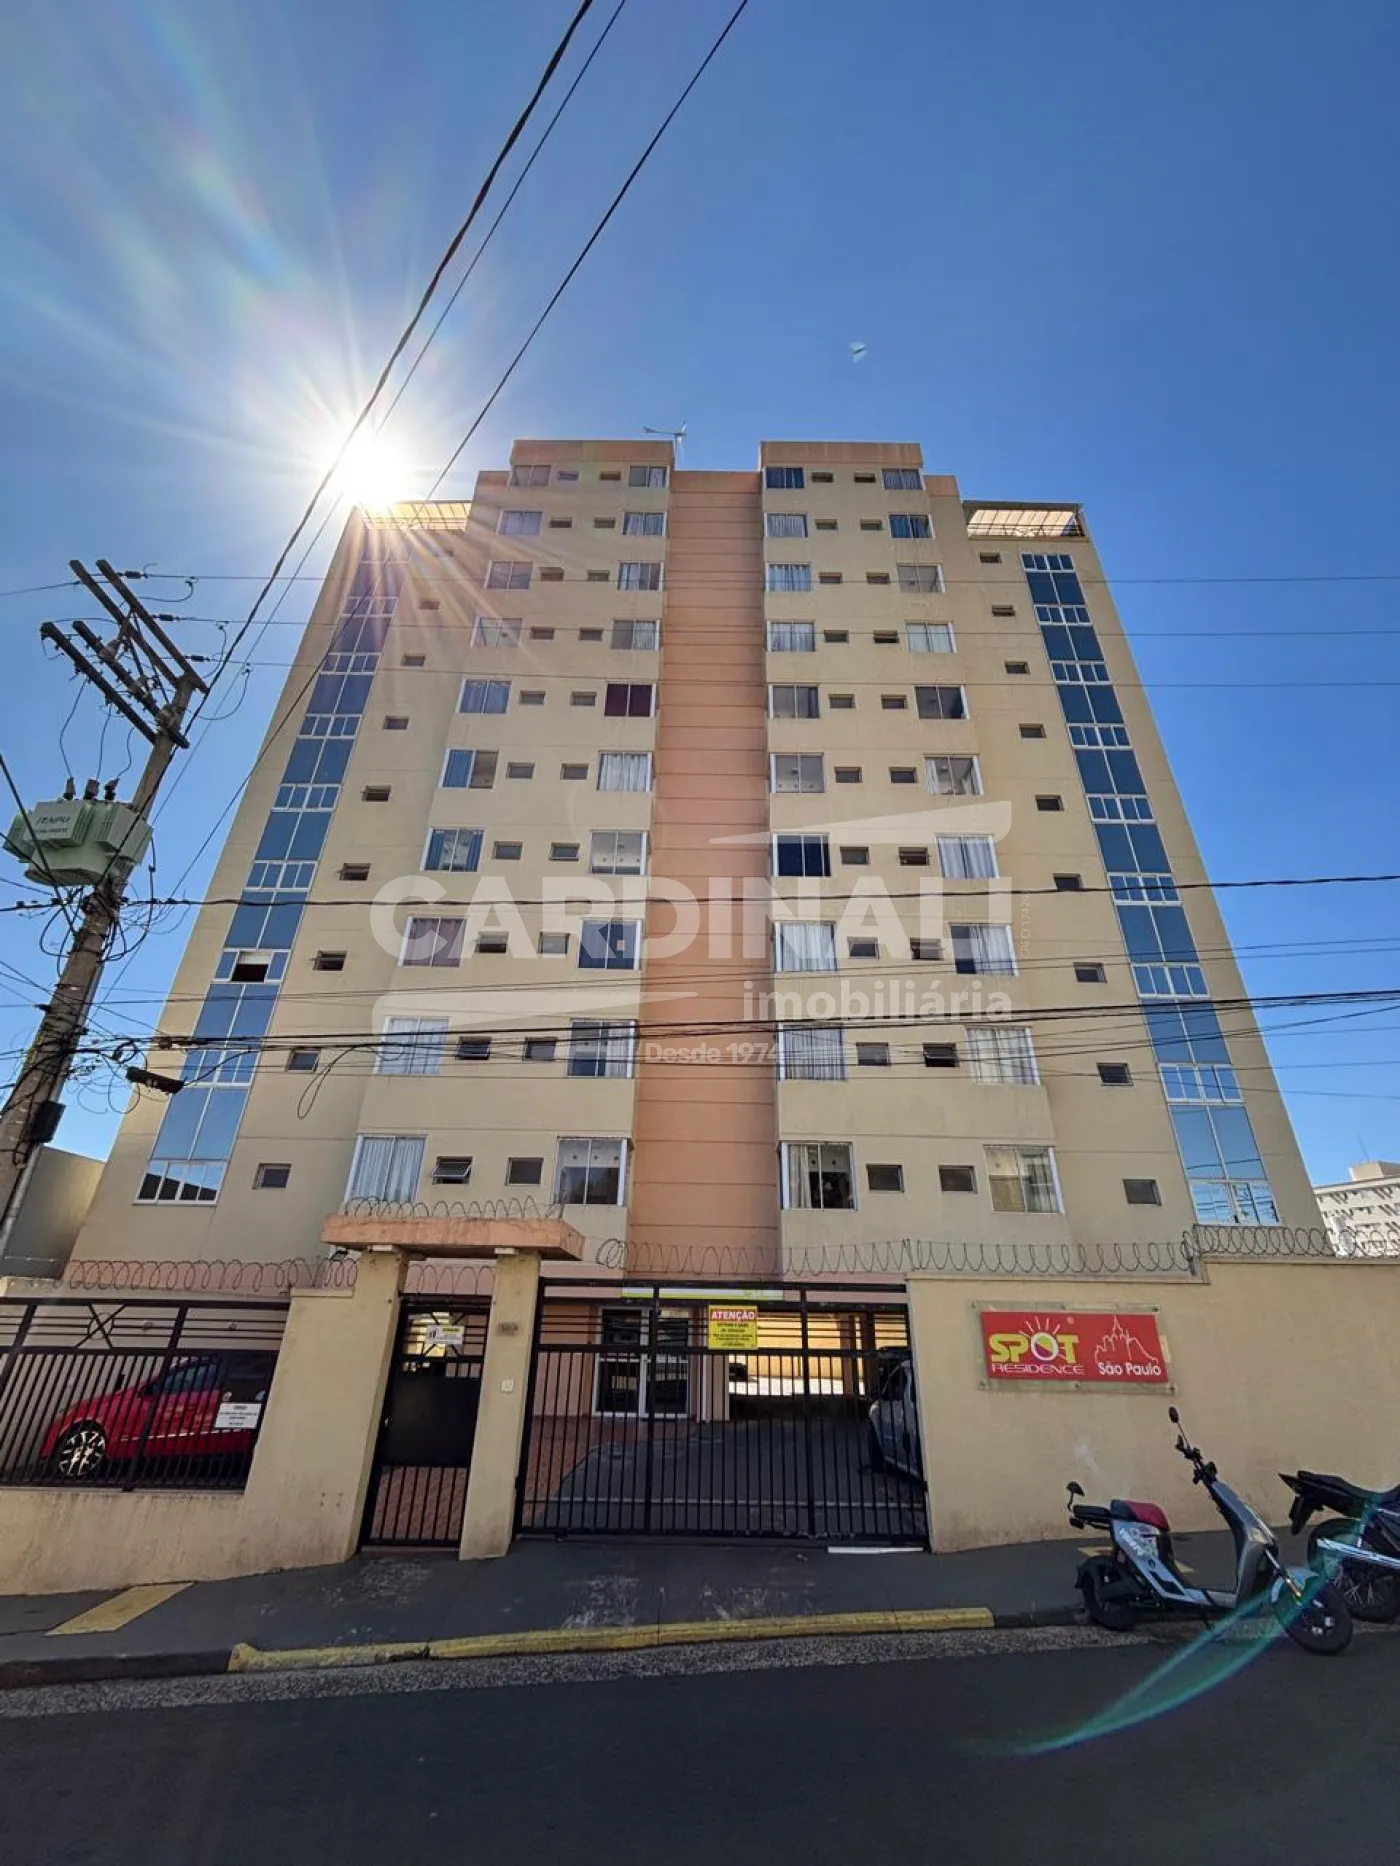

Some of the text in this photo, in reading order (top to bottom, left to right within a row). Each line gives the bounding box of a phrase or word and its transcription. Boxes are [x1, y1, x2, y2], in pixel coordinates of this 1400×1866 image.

[711, 1310, 755, 1322] ATENÇÃO
[989, 1331, 1080, 1364] SPOT
[991, 1363, 1085, 1376] RESIDENCE
[1097, 1361, 1162, 1376] São Paulo
